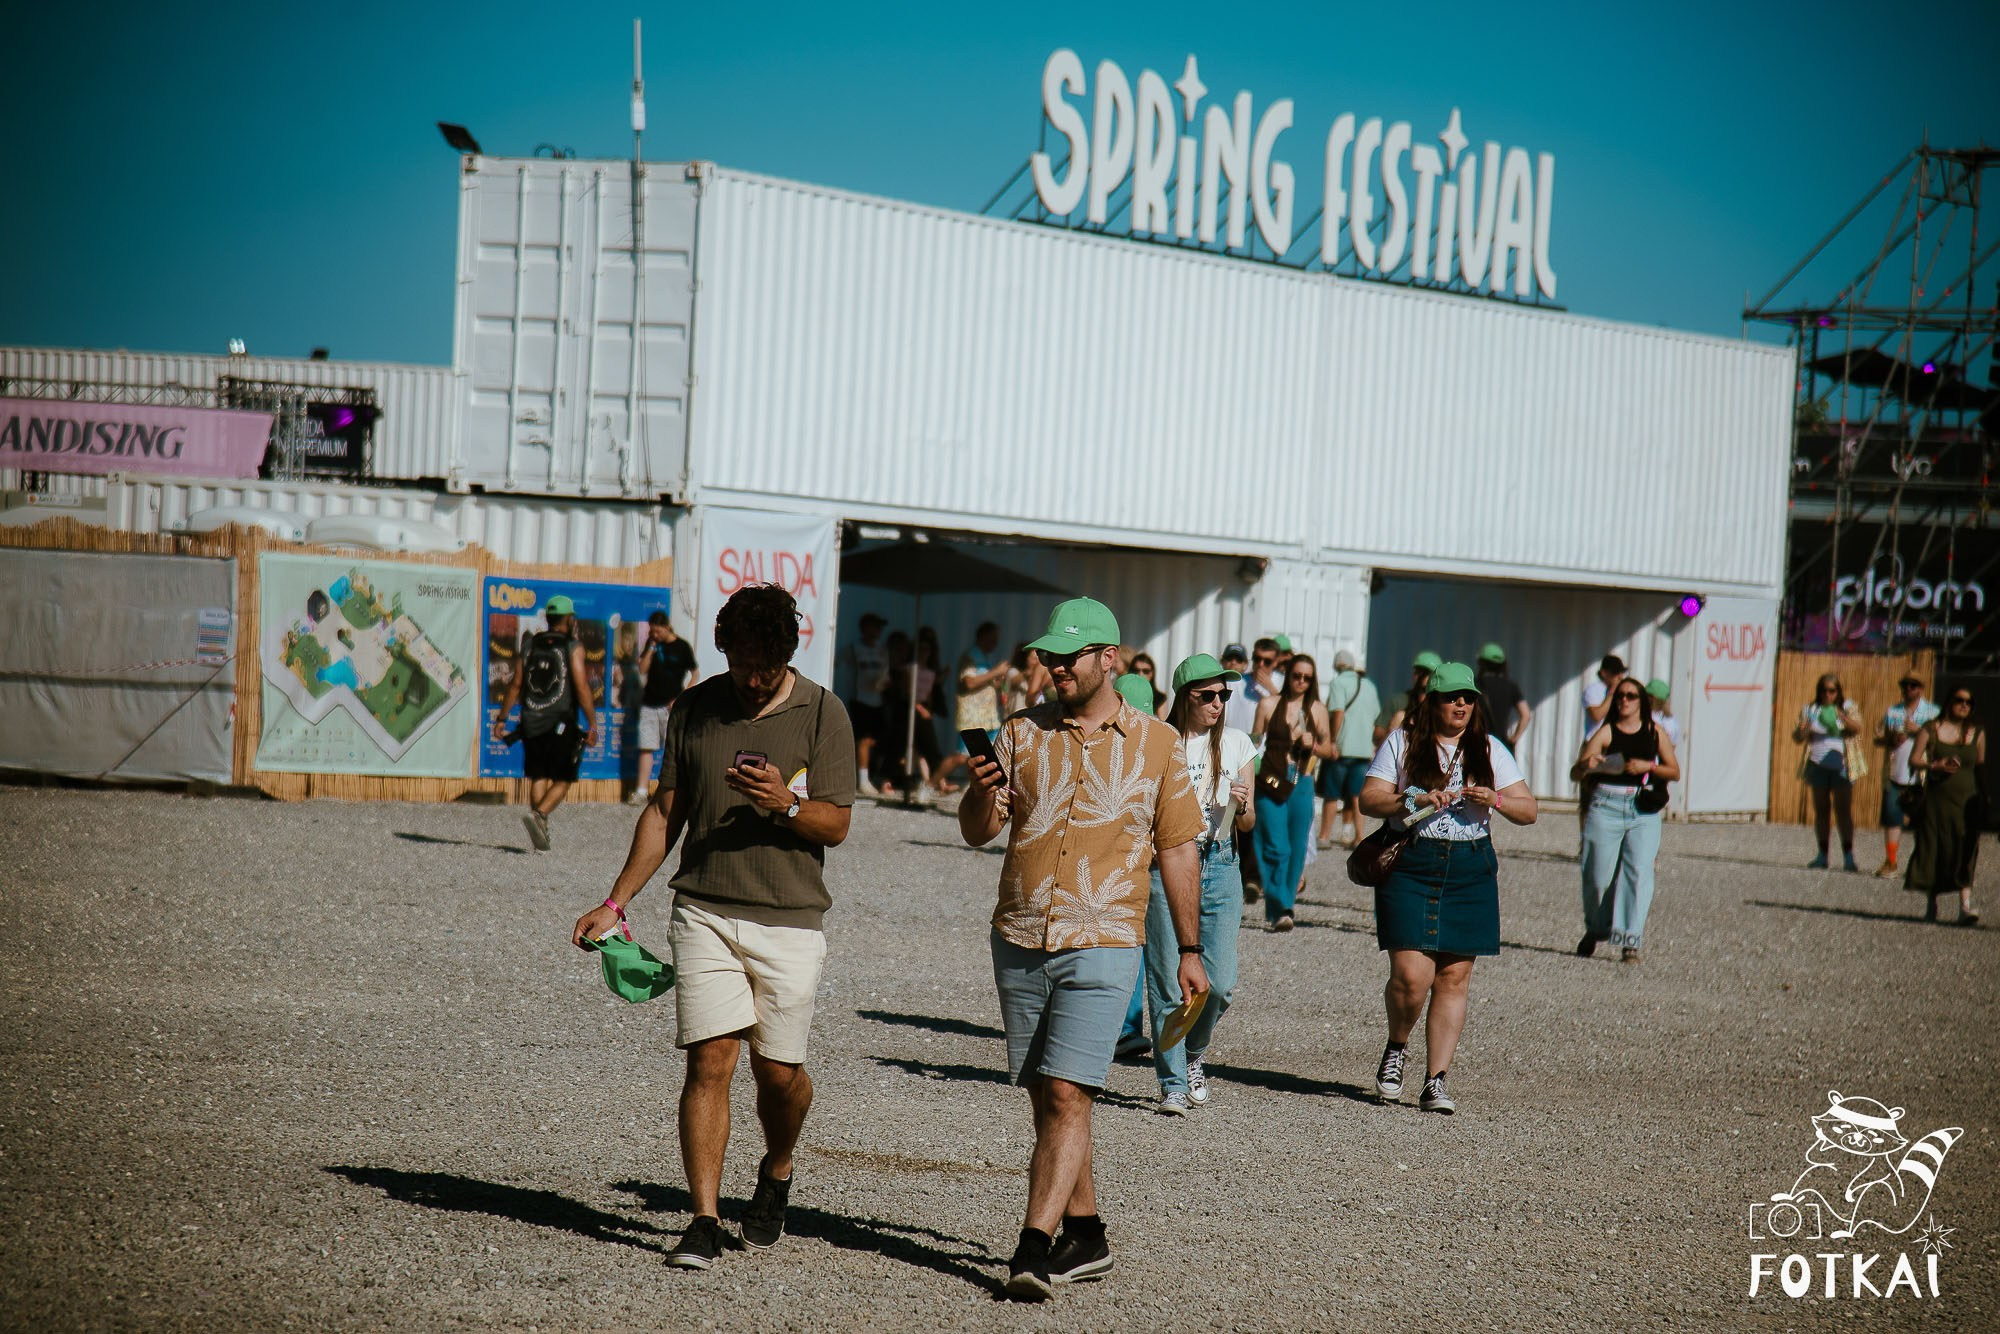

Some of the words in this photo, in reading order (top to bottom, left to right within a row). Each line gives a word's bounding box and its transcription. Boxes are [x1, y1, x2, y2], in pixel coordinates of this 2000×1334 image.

[1030, 48, 1295, 257] SPRING
[1321, 107, 1557, 300] FESTIVAL
[717, 547, 817, 599] SALIDA
[1834, 563, 1986, 640] ploom
[1706, 622, 1766, 661] SALIDA
